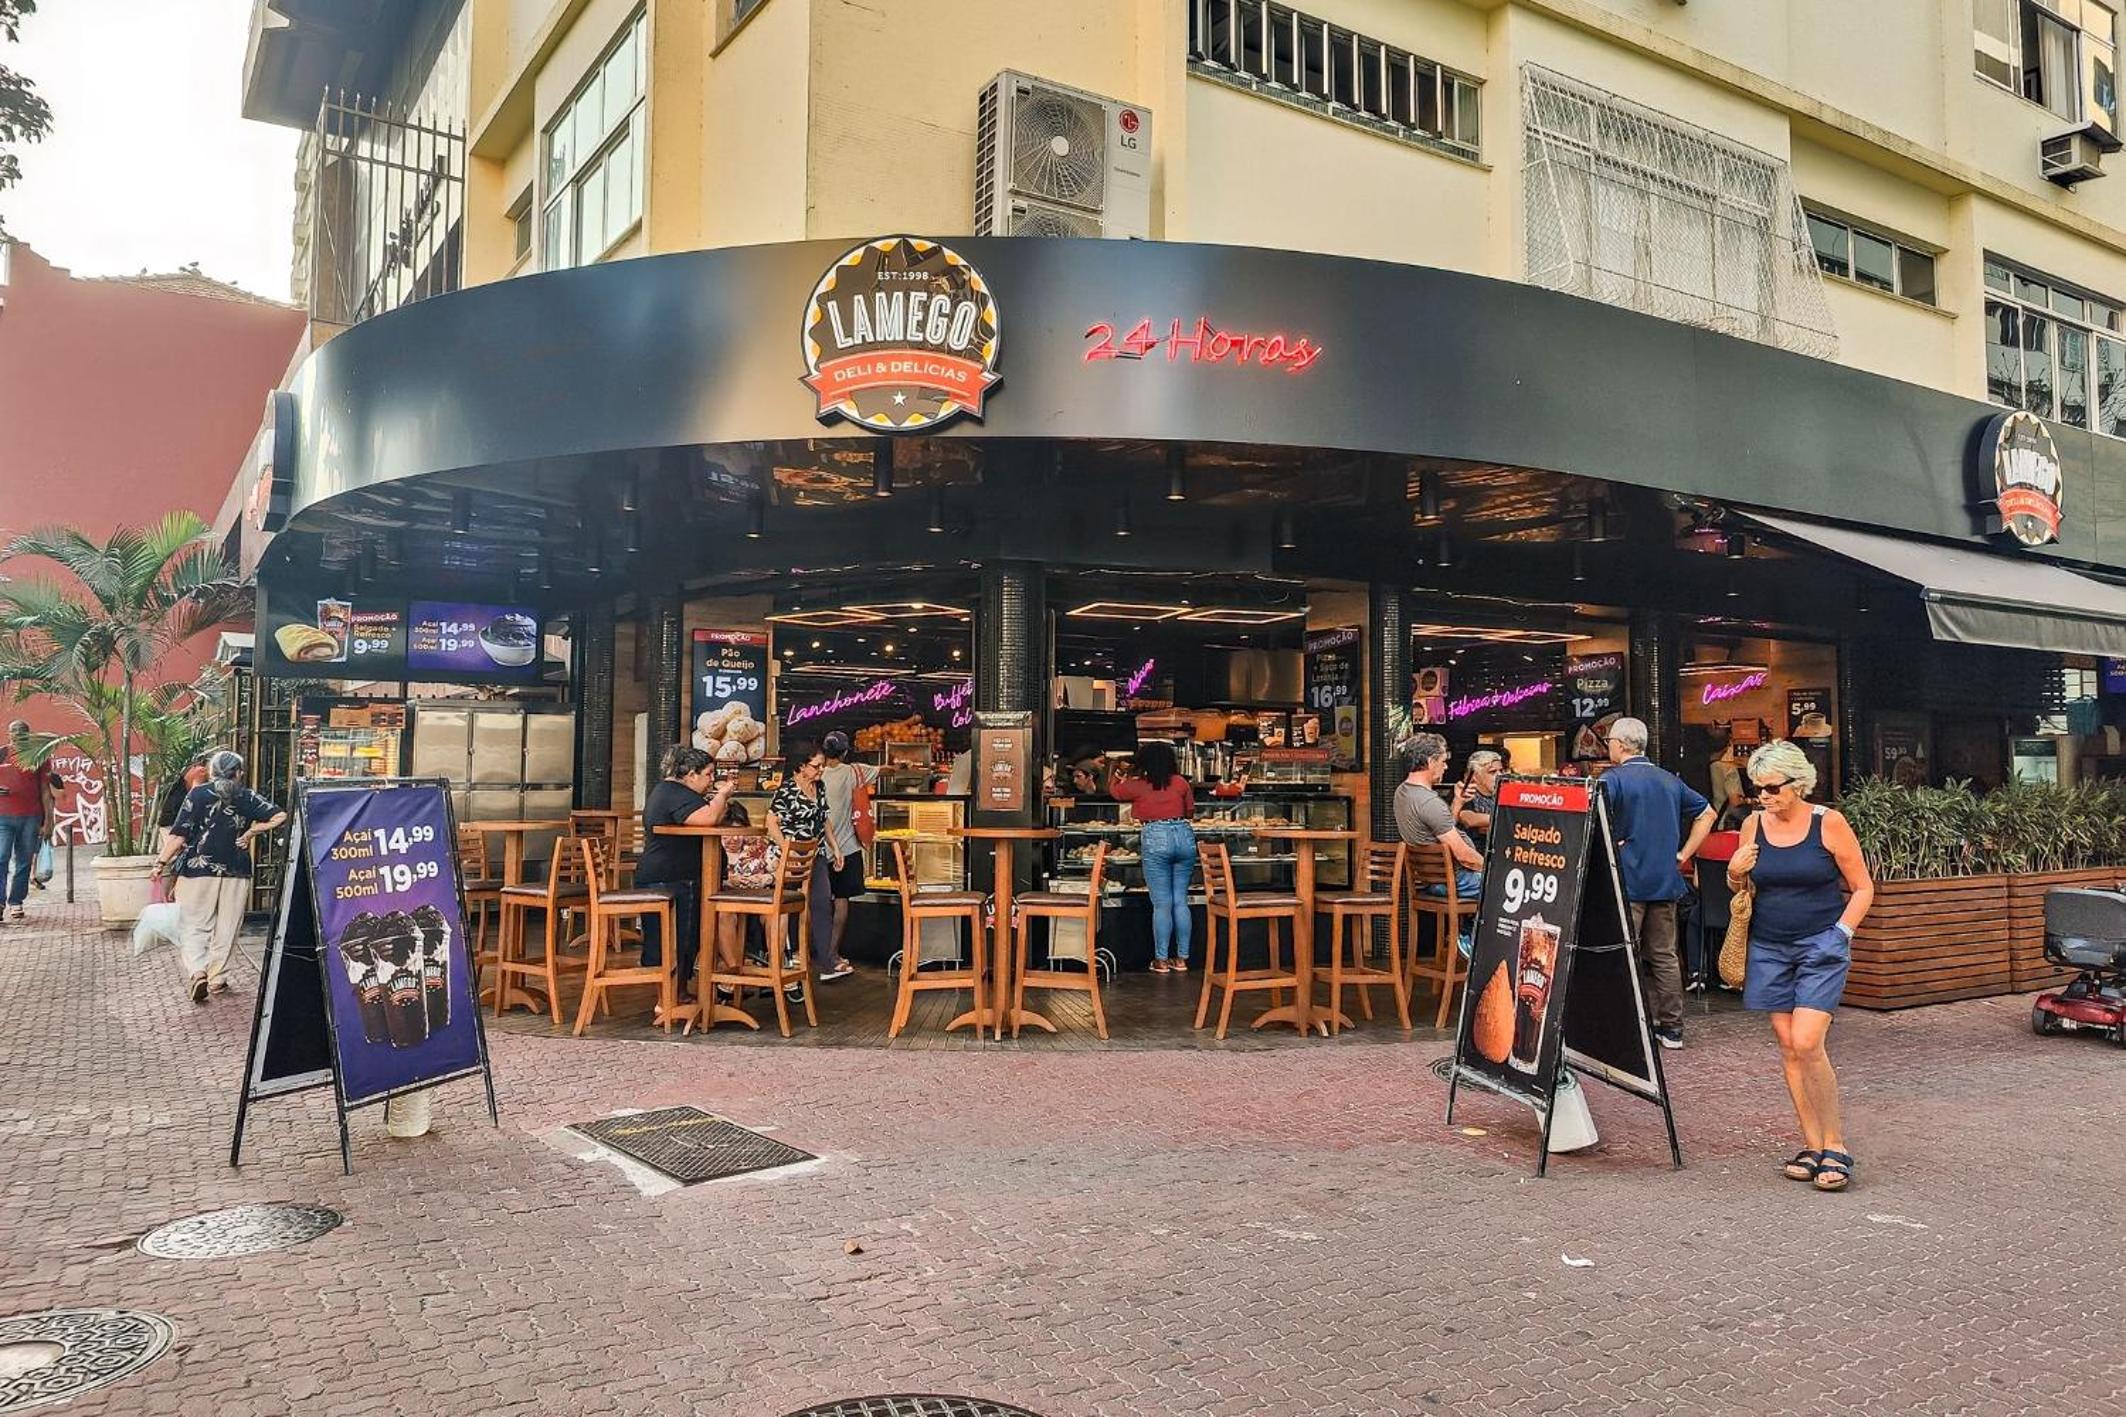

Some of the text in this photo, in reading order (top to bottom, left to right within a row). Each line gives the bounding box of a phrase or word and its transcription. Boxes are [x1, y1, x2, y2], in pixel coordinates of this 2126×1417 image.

[1120, 135, 1137, 149] LG
[827, 291, 977, 350] LAMEGO
[1085, 316, 1322, 375] 24 Horas
[833, 366, 872, 382] DELI
[875, 362, 887, 374] &
[353, 638, 389, 655] 9,99
[721, 648, 741, 657] Pão
[706, 658, 755, 670] de Queijo
[702, 675, 759, 698] 15,99
[1576, 678, 1609, 690] Pizza
[786, 679, 897, 726] Lanchonete
[1311, 685, 1348, 708] 16,99
[1572, 697, 1610, 718] 12,99
[1519, 791, 1564, 806] PROMOÇÃO
[374, 825, 435, 856] 14,99
[1513, 822, 1562, 845] Salgado
[331, 844, 374, 860] 300ml
[1504, 845, 1566, 870] + Refresco
[378, 861, 439, 894] 19,99
[335, 882, 379, 900] 500ml
[1502, 867, 1559, 914] 9,99
